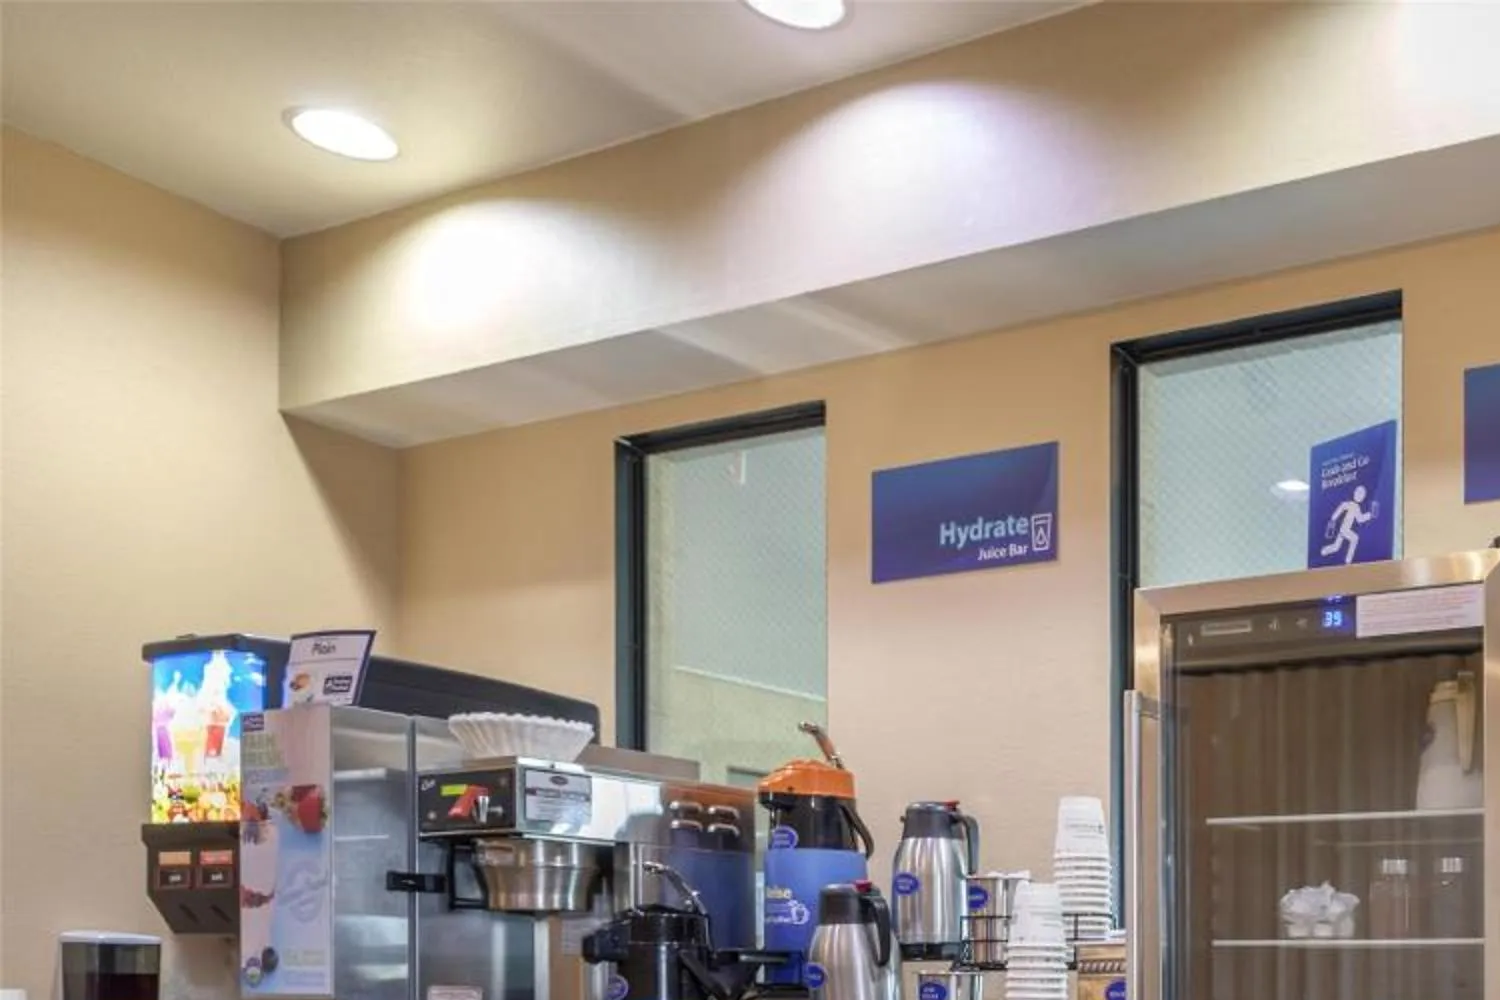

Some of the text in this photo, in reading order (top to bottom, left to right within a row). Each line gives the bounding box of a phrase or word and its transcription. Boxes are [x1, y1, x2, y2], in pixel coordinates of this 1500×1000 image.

[938, 514, 1029, 549] Hydrate
[976, 543, 1029, 561] Juice Bar
